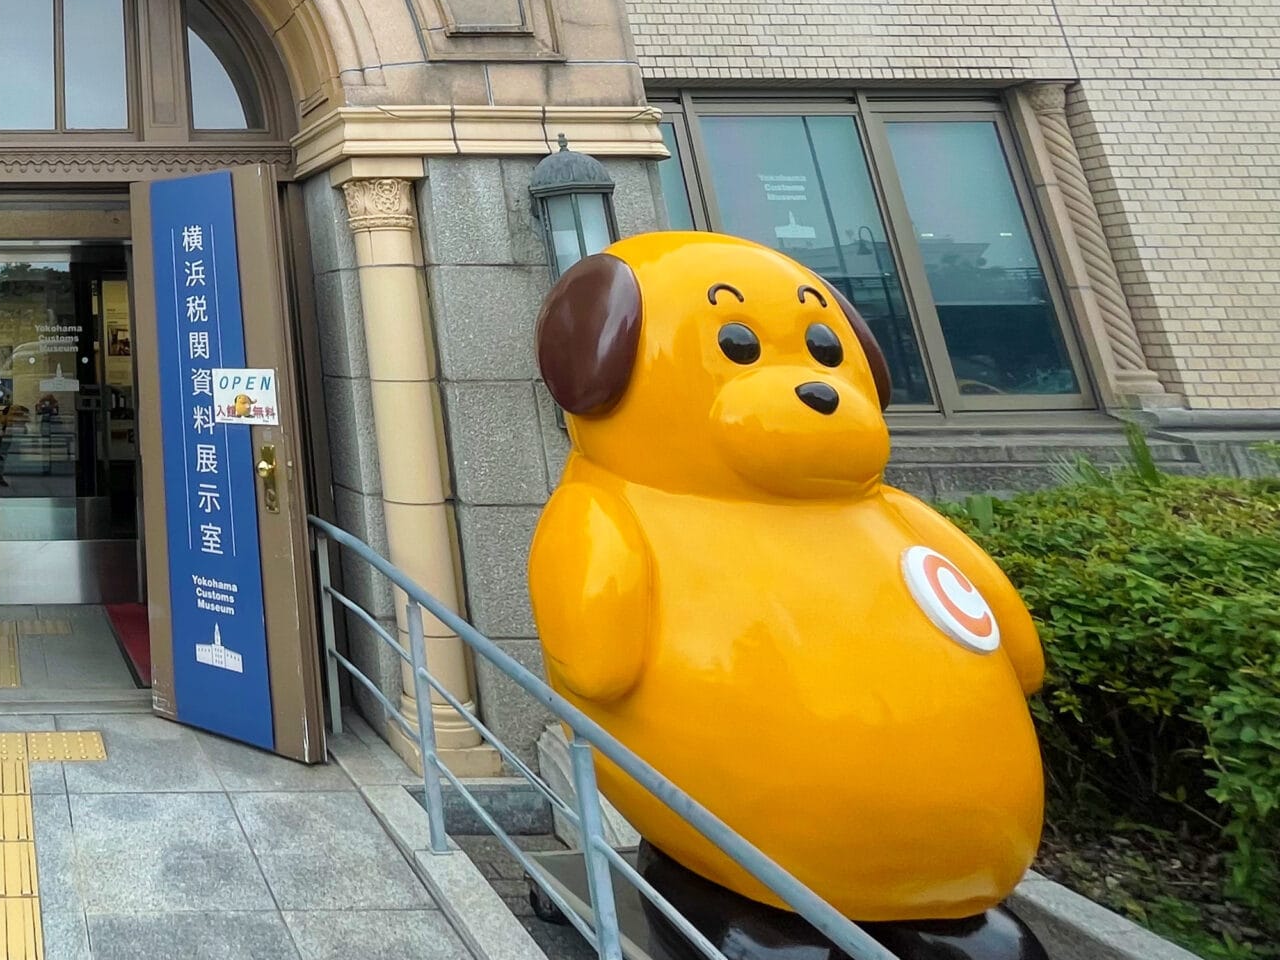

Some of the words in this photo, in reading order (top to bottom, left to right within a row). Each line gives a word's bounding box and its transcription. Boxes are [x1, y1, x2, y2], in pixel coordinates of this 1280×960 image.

[34, 324, 83, 333] Yokohama
[38, 334, 80, 343] Customs
[182, 224, 224, 556] 横浜税関資料展示室
[219, 375, 271, 391] OPEN
[191, 574, 238, 593] Yokohama
[195, 587, 235, 604] Customs
[922, 554, 993, 638] C
[197, 598, 235, 616] Museum
